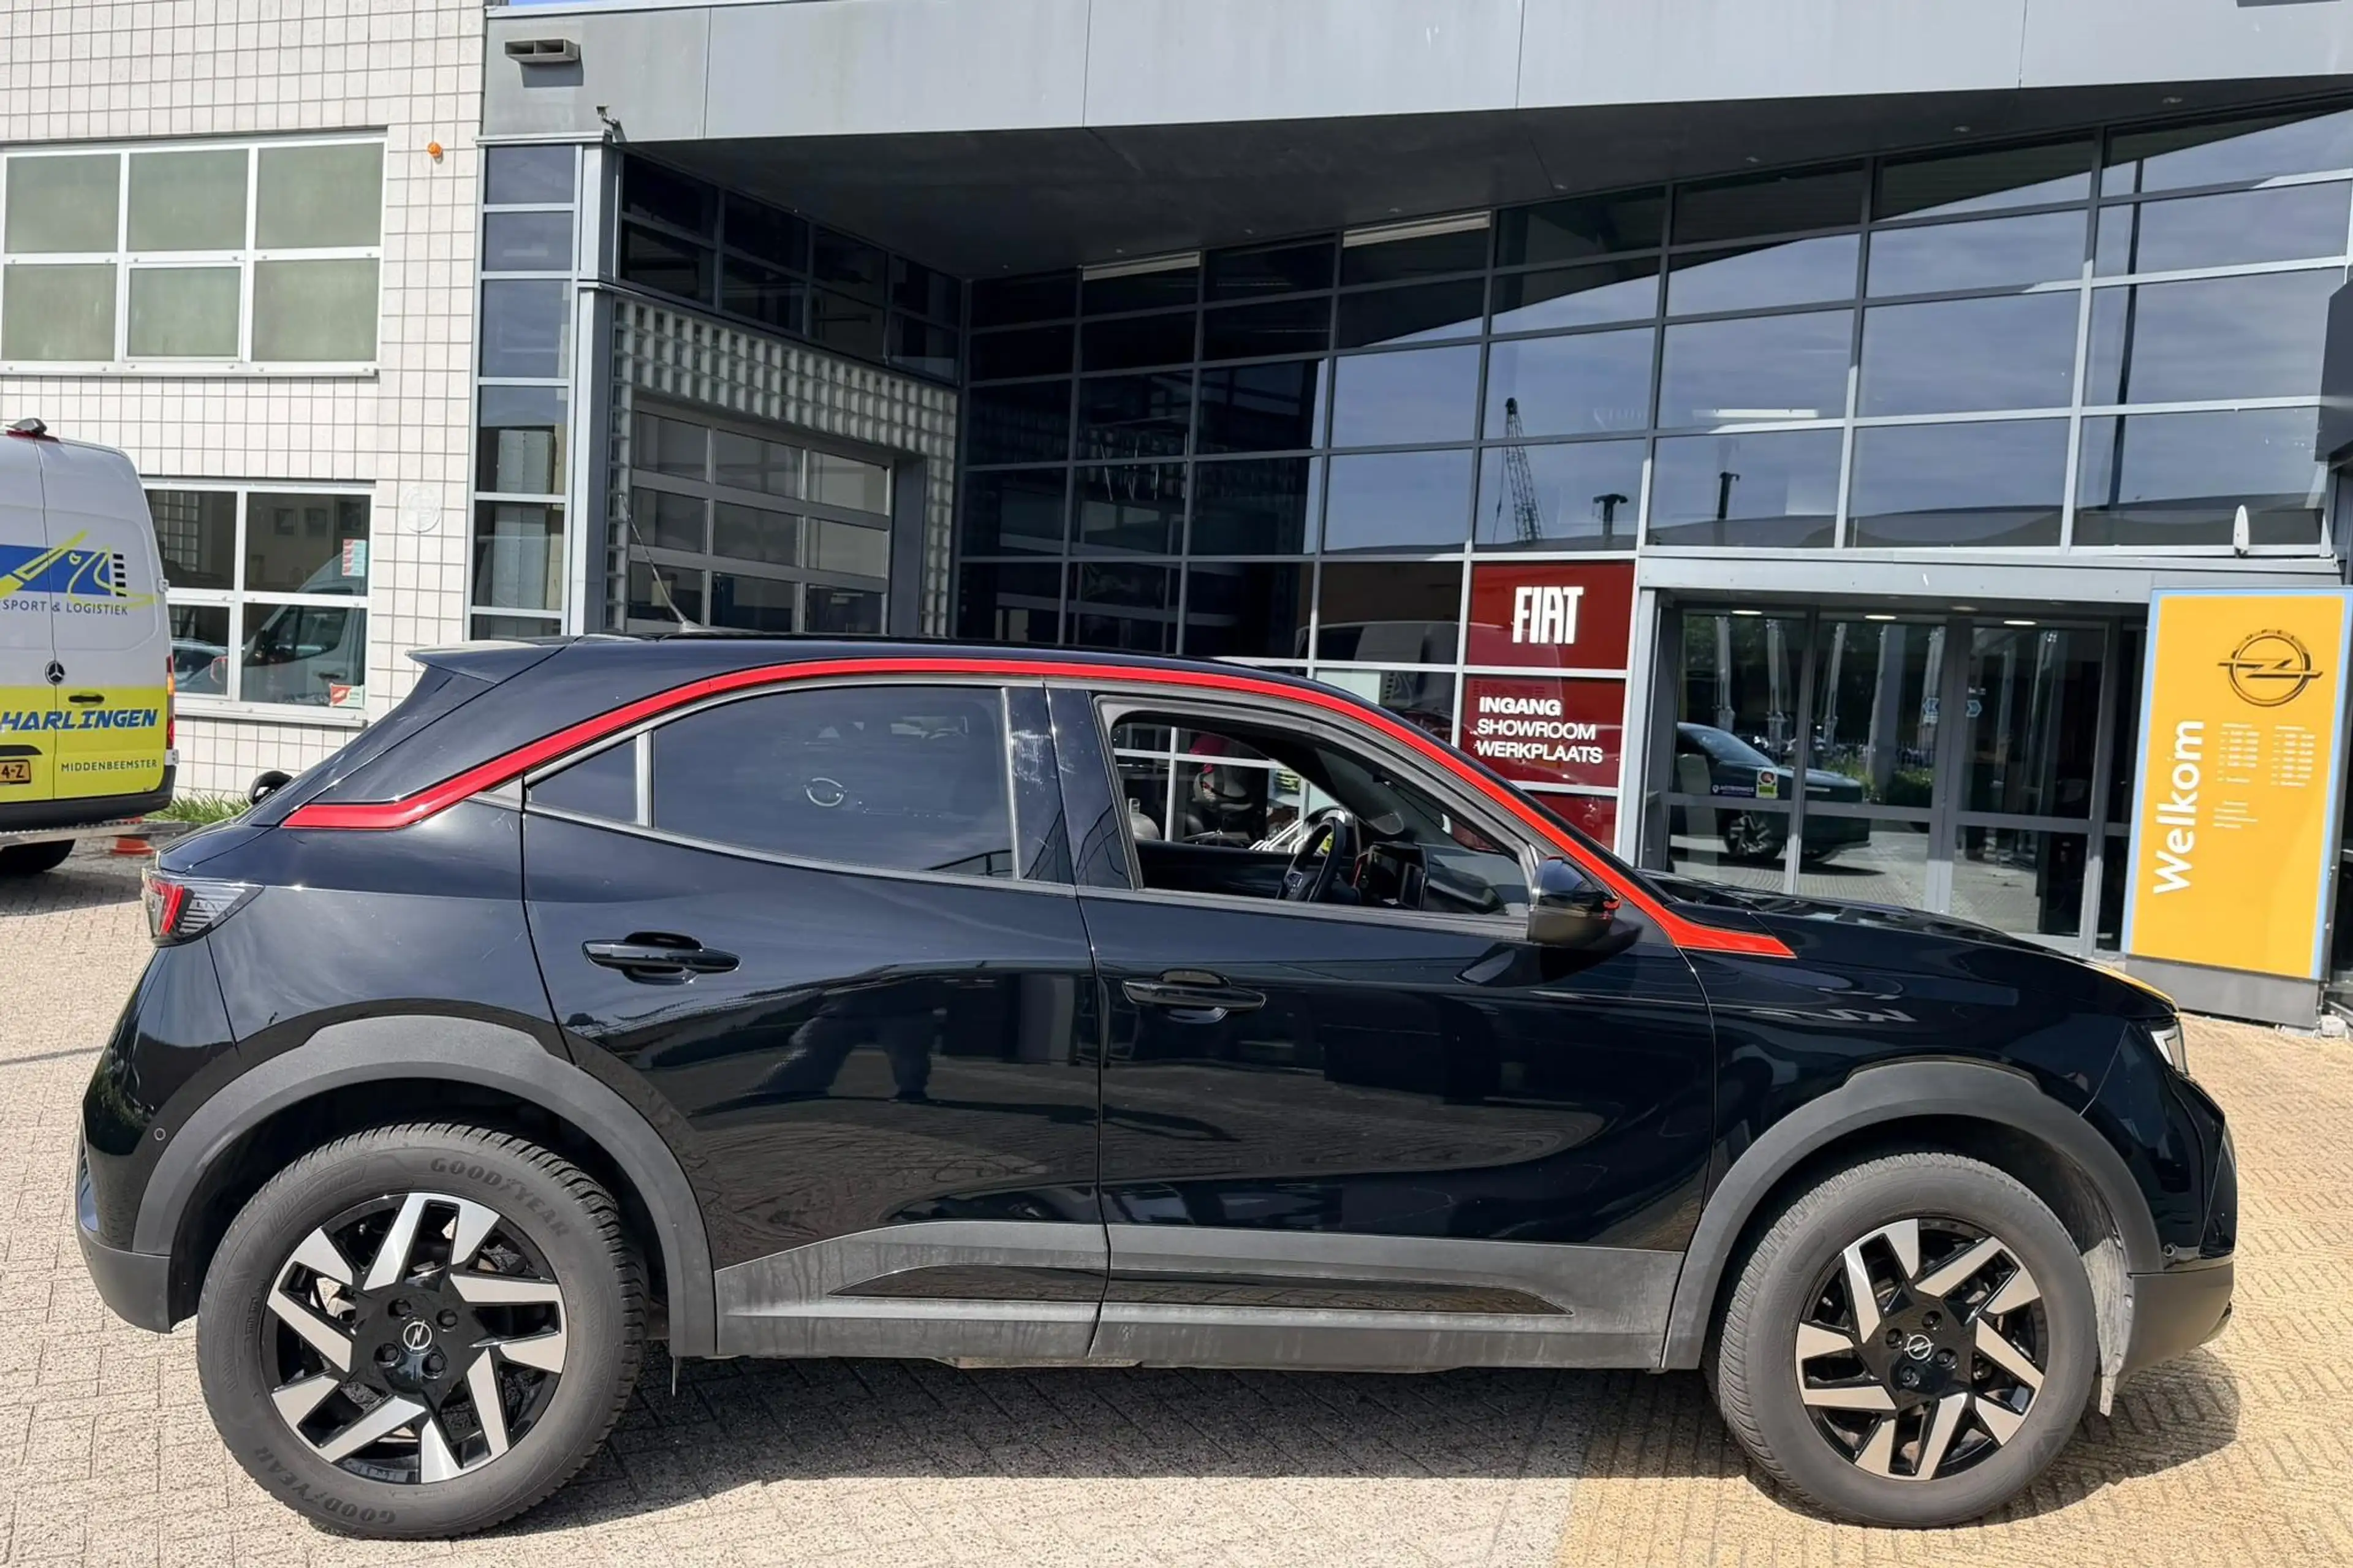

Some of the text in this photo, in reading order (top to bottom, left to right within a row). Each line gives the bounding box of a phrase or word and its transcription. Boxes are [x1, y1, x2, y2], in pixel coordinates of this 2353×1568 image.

[0, 599, 47, 612] SPORT
[66, 601, 128, 616] LOGISTIEK
[1512, 586, 1584, 644] FIAT
[1479, 696, 1562, 716] INGANG
[0, 708, 159, 730] HARLINGEN
[1477, 719, 1597, 740] SHOWROOM
[1476, 741, 1604, 763] WERKPLAATS
[61, 759, 157, 773] MIDDENBEEMSTER
[2153, 720, 2205, 894] Welkom
[430, 1157, 570, 1237] GOODYEAR
[255, 1446, 396, 1524] GOODYEAR
